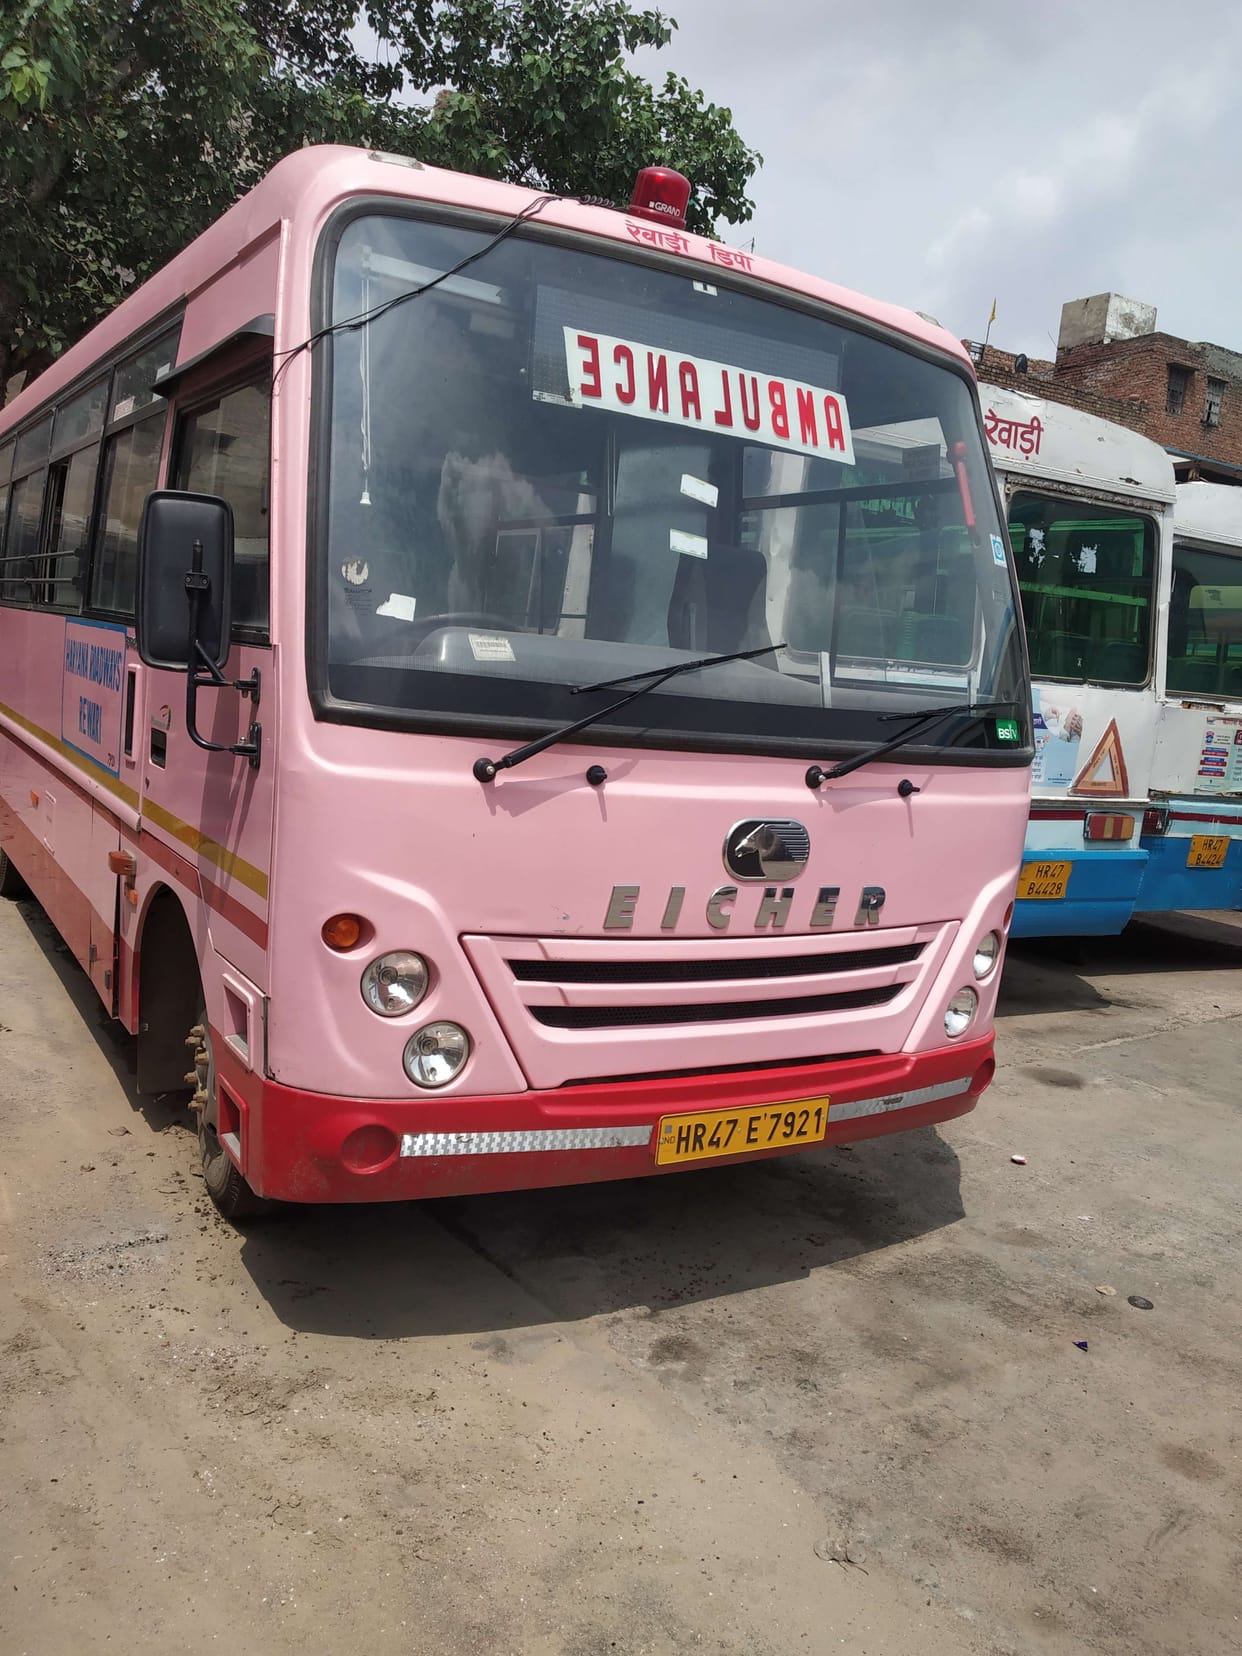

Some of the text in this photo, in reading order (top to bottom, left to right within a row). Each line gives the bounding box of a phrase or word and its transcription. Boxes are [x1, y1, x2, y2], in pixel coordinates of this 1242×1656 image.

[655, 201, 681, 217] GRAND
[984, 408, 1044, 460] रेवाड़ी
[1035, 864, 1065, 879] HR47
[1026, 881, 1063, 896] B4428
[602, 885, 886, 929] EICHER
[675, 1118, 738, 1154] HR47
